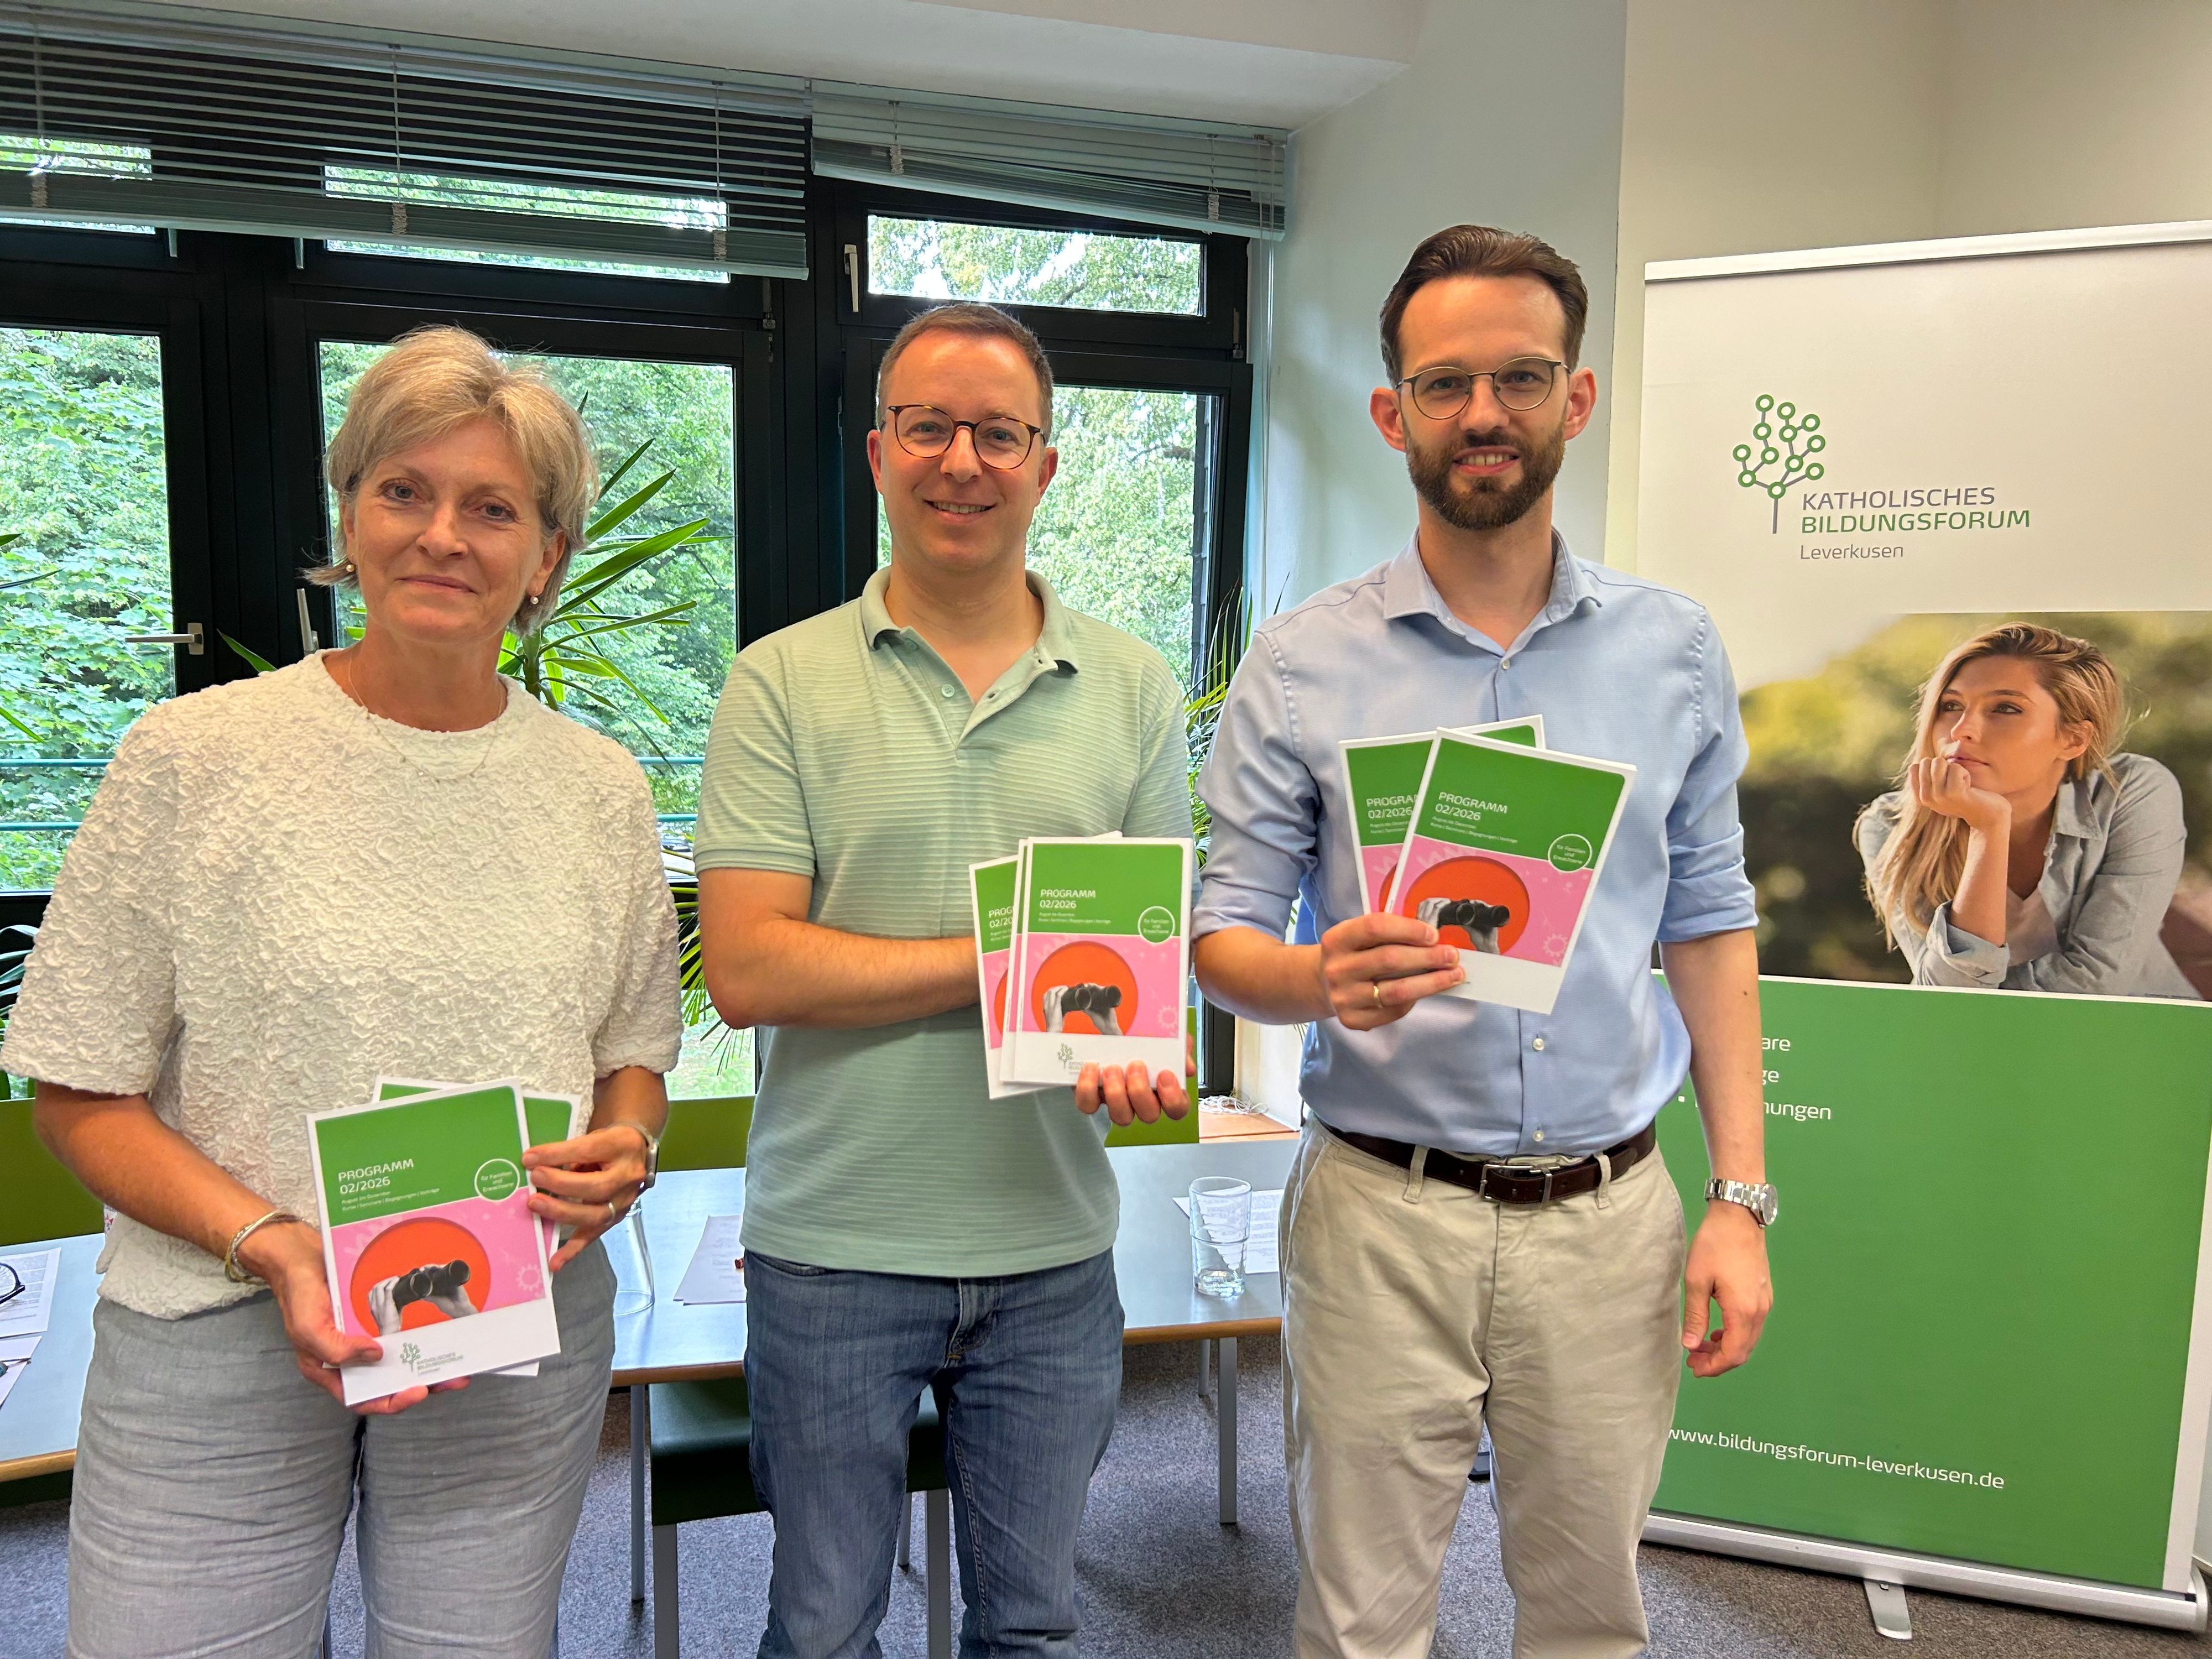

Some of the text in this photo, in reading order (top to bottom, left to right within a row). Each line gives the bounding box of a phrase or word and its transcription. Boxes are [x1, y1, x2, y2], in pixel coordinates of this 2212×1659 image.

[1802, 487, 1996, 511] KATHOLISCHES
[1801, 509, 2031, 534] BILDUNGSFORUM
[1800, 544, 1903, 560] Leverkusen
[1438, 791, 1509, 814] PROGRAMM
[1368, 806, 1412, 819] 02/2026
[1435, 803, 1481, 821] 02/2026
[1040, 889, 1096, 899] PROGRAMM
[1039, 900, 1077, 909] 02/2026
[338, 1159, 414, 1182] PROGRAMM
[340, 1176, 390, 1194] 02/2026
[1668, 1428, 2005, 1489] www.bildungsforum-leverkusen.de
